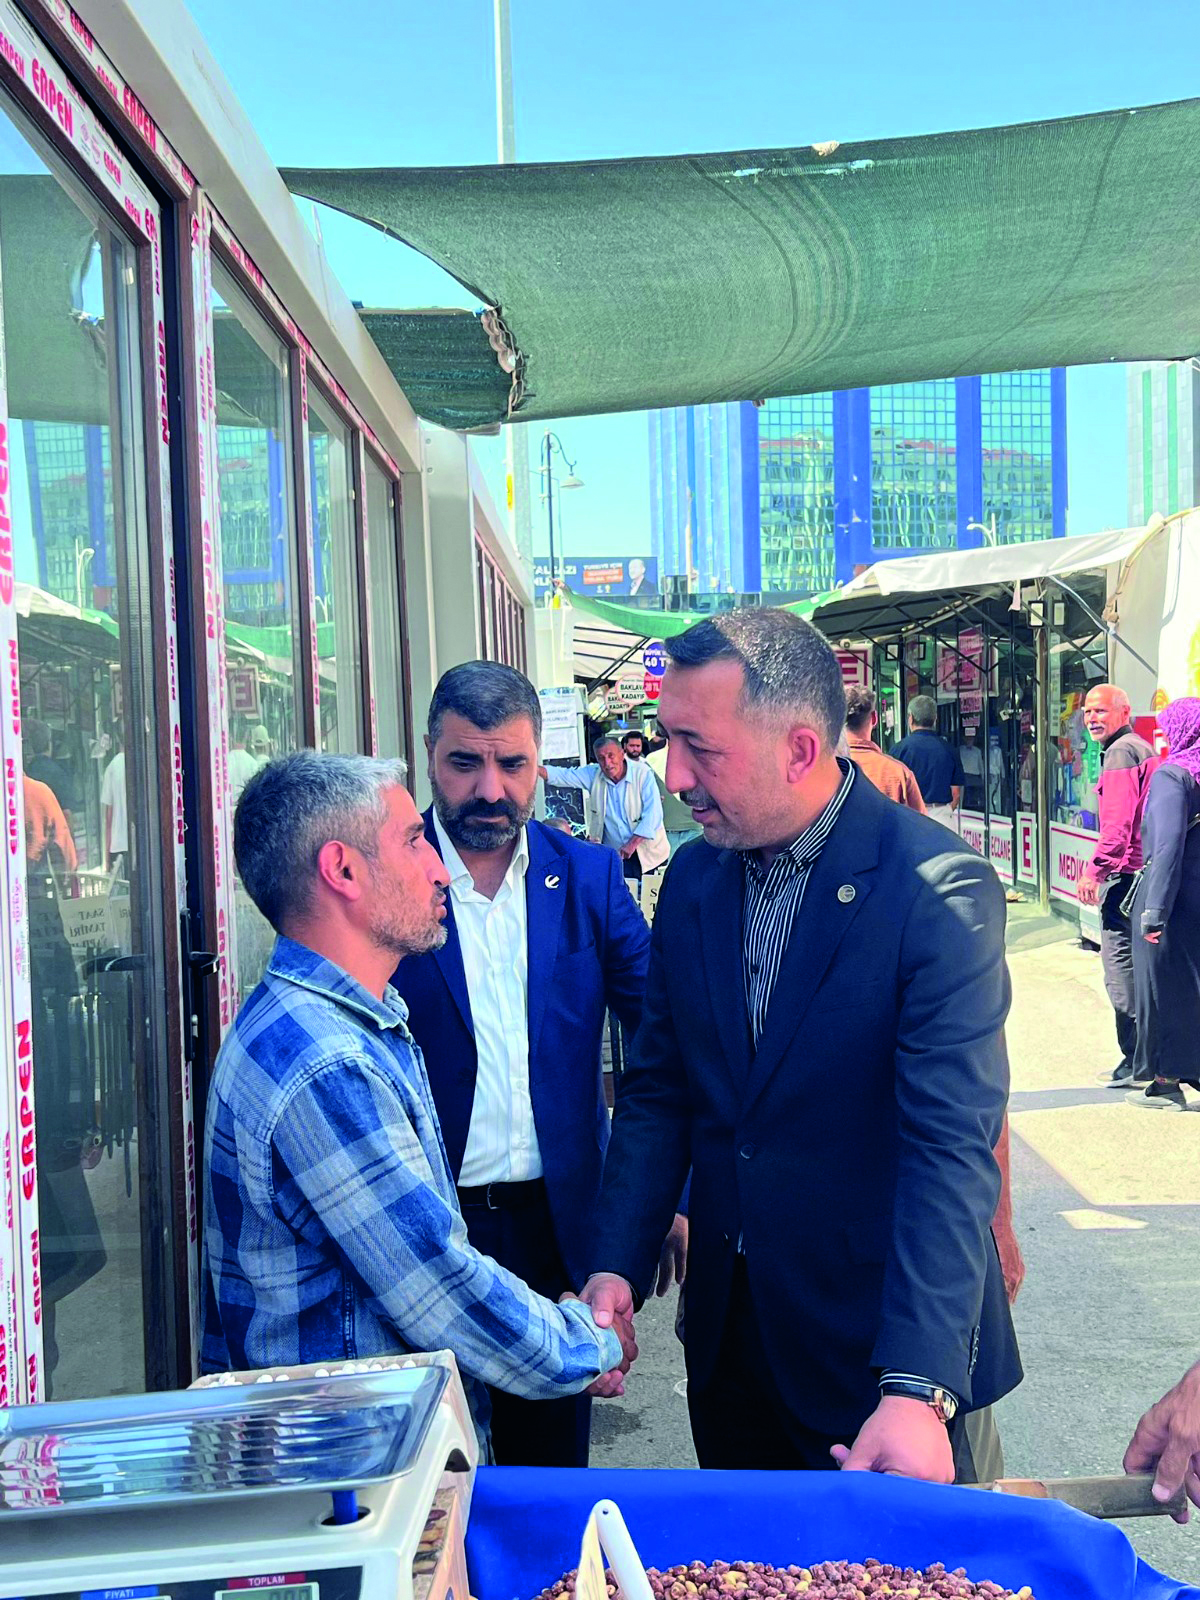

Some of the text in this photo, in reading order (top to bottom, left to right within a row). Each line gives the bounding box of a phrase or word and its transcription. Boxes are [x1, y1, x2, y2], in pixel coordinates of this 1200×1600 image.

[32, 58, 74, 139] ERPEN
[123, 86, 157, 152] ERPEN
[158, 320, 169, 445] ERPEN
[8, 639, 20, 735] ERPEN
[644, 656, 658, 667] 40
[5, 757, 18, 855] ERPEN
[173, 723, 184, 845] ERPEN
[991, 836, 1011, 861] ECZANE
[1023, 827, 1031, 868] E
[16, 1019, 36, 1200] ERPEN
[30, 1229, 42, 1326] ERPEN
[0, 1323, 9, 1406] ERPE
[248, 1575, 286, 1586] TOPLAM
